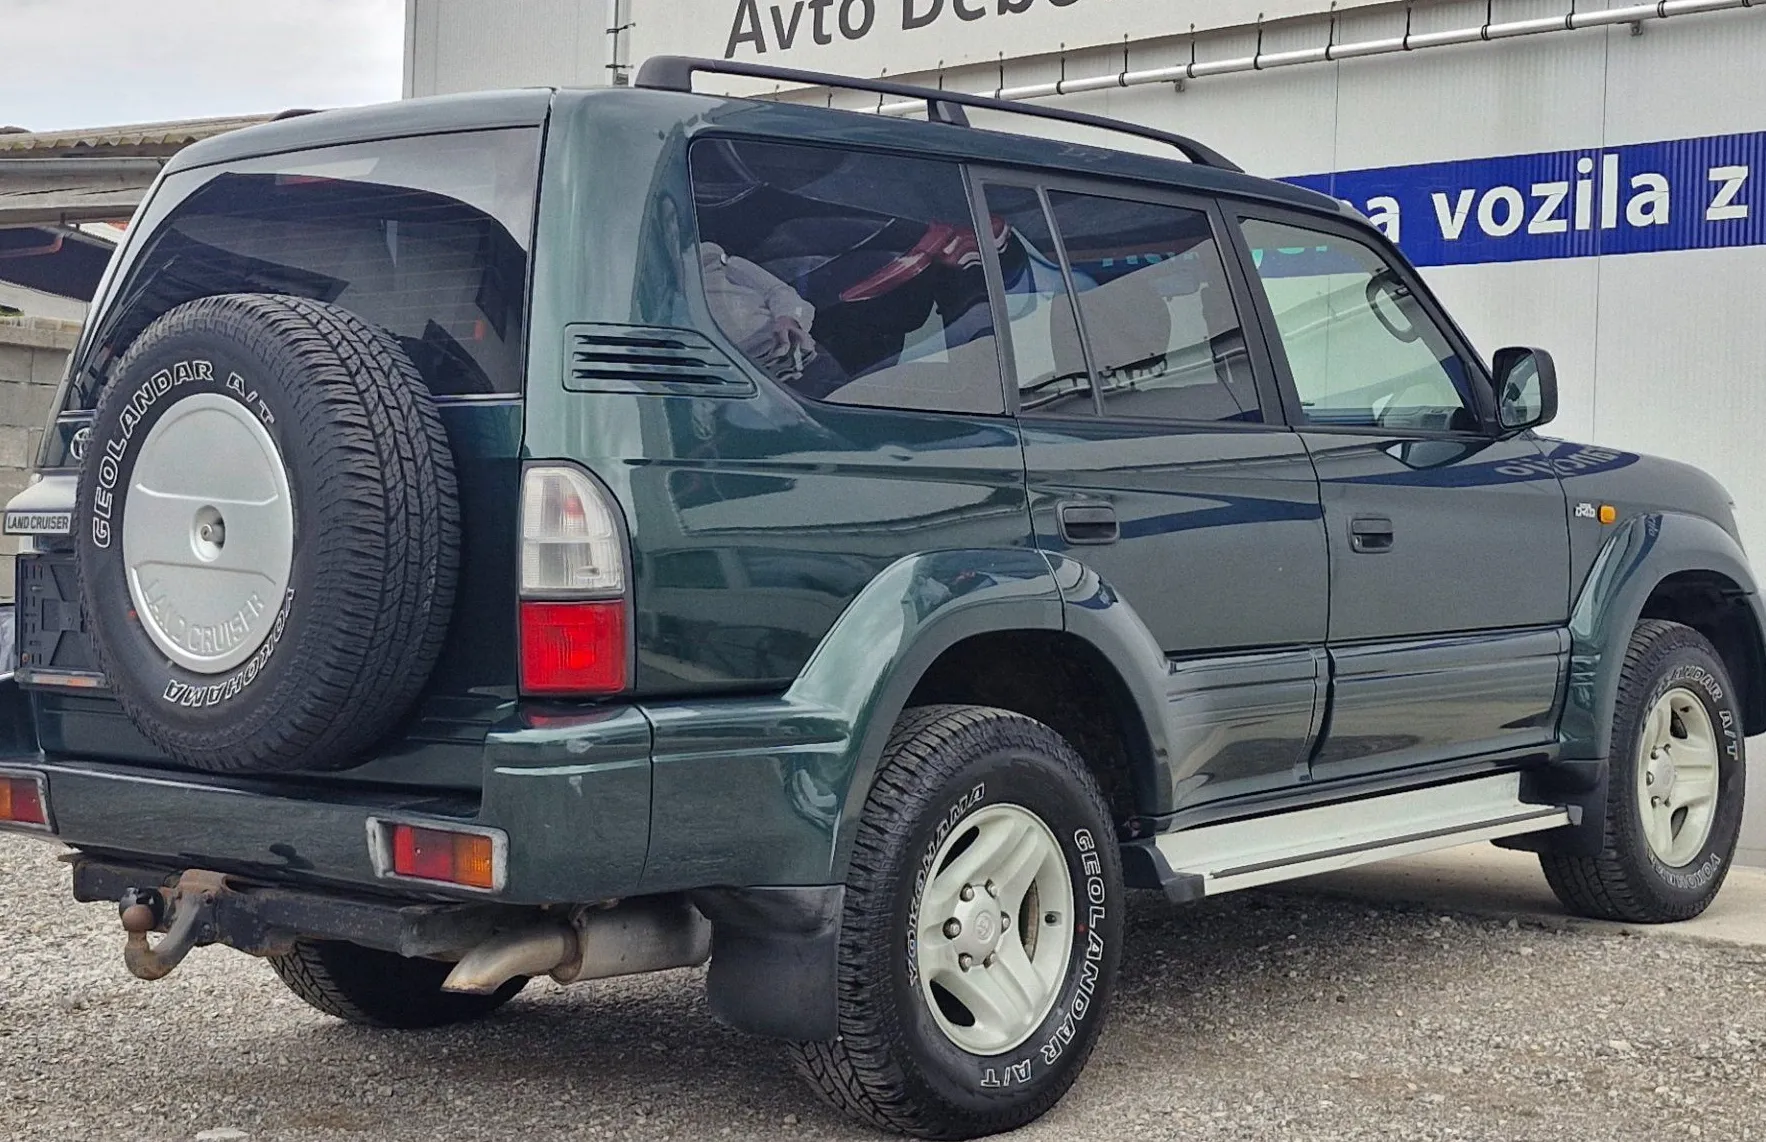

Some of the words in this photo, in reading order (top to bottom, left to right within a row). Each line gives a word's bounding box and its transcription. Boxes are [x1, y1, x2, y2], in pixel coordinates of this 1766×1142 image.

[724, 0, 876, 59] Avto
[1431, 153, 1670, 241] vozila
[1707, 165, 1749, 221] z
[93, 360, 214, 548] GEOLANDAR
[227, 372, 276, 425] A/T
[7, 516, 29, 529] LAND
[30, 516, 69, 529] CRUISER
[163, 587, 296, 707] YOKOHAMA
[1719, 709, 1738, 761] A/T
[908, 782, 985, 987] YOKOHAMA
[1040, 828, 1106, 1065] GEOLANDAR
[980, 1058, 1031, 1088] A/T
